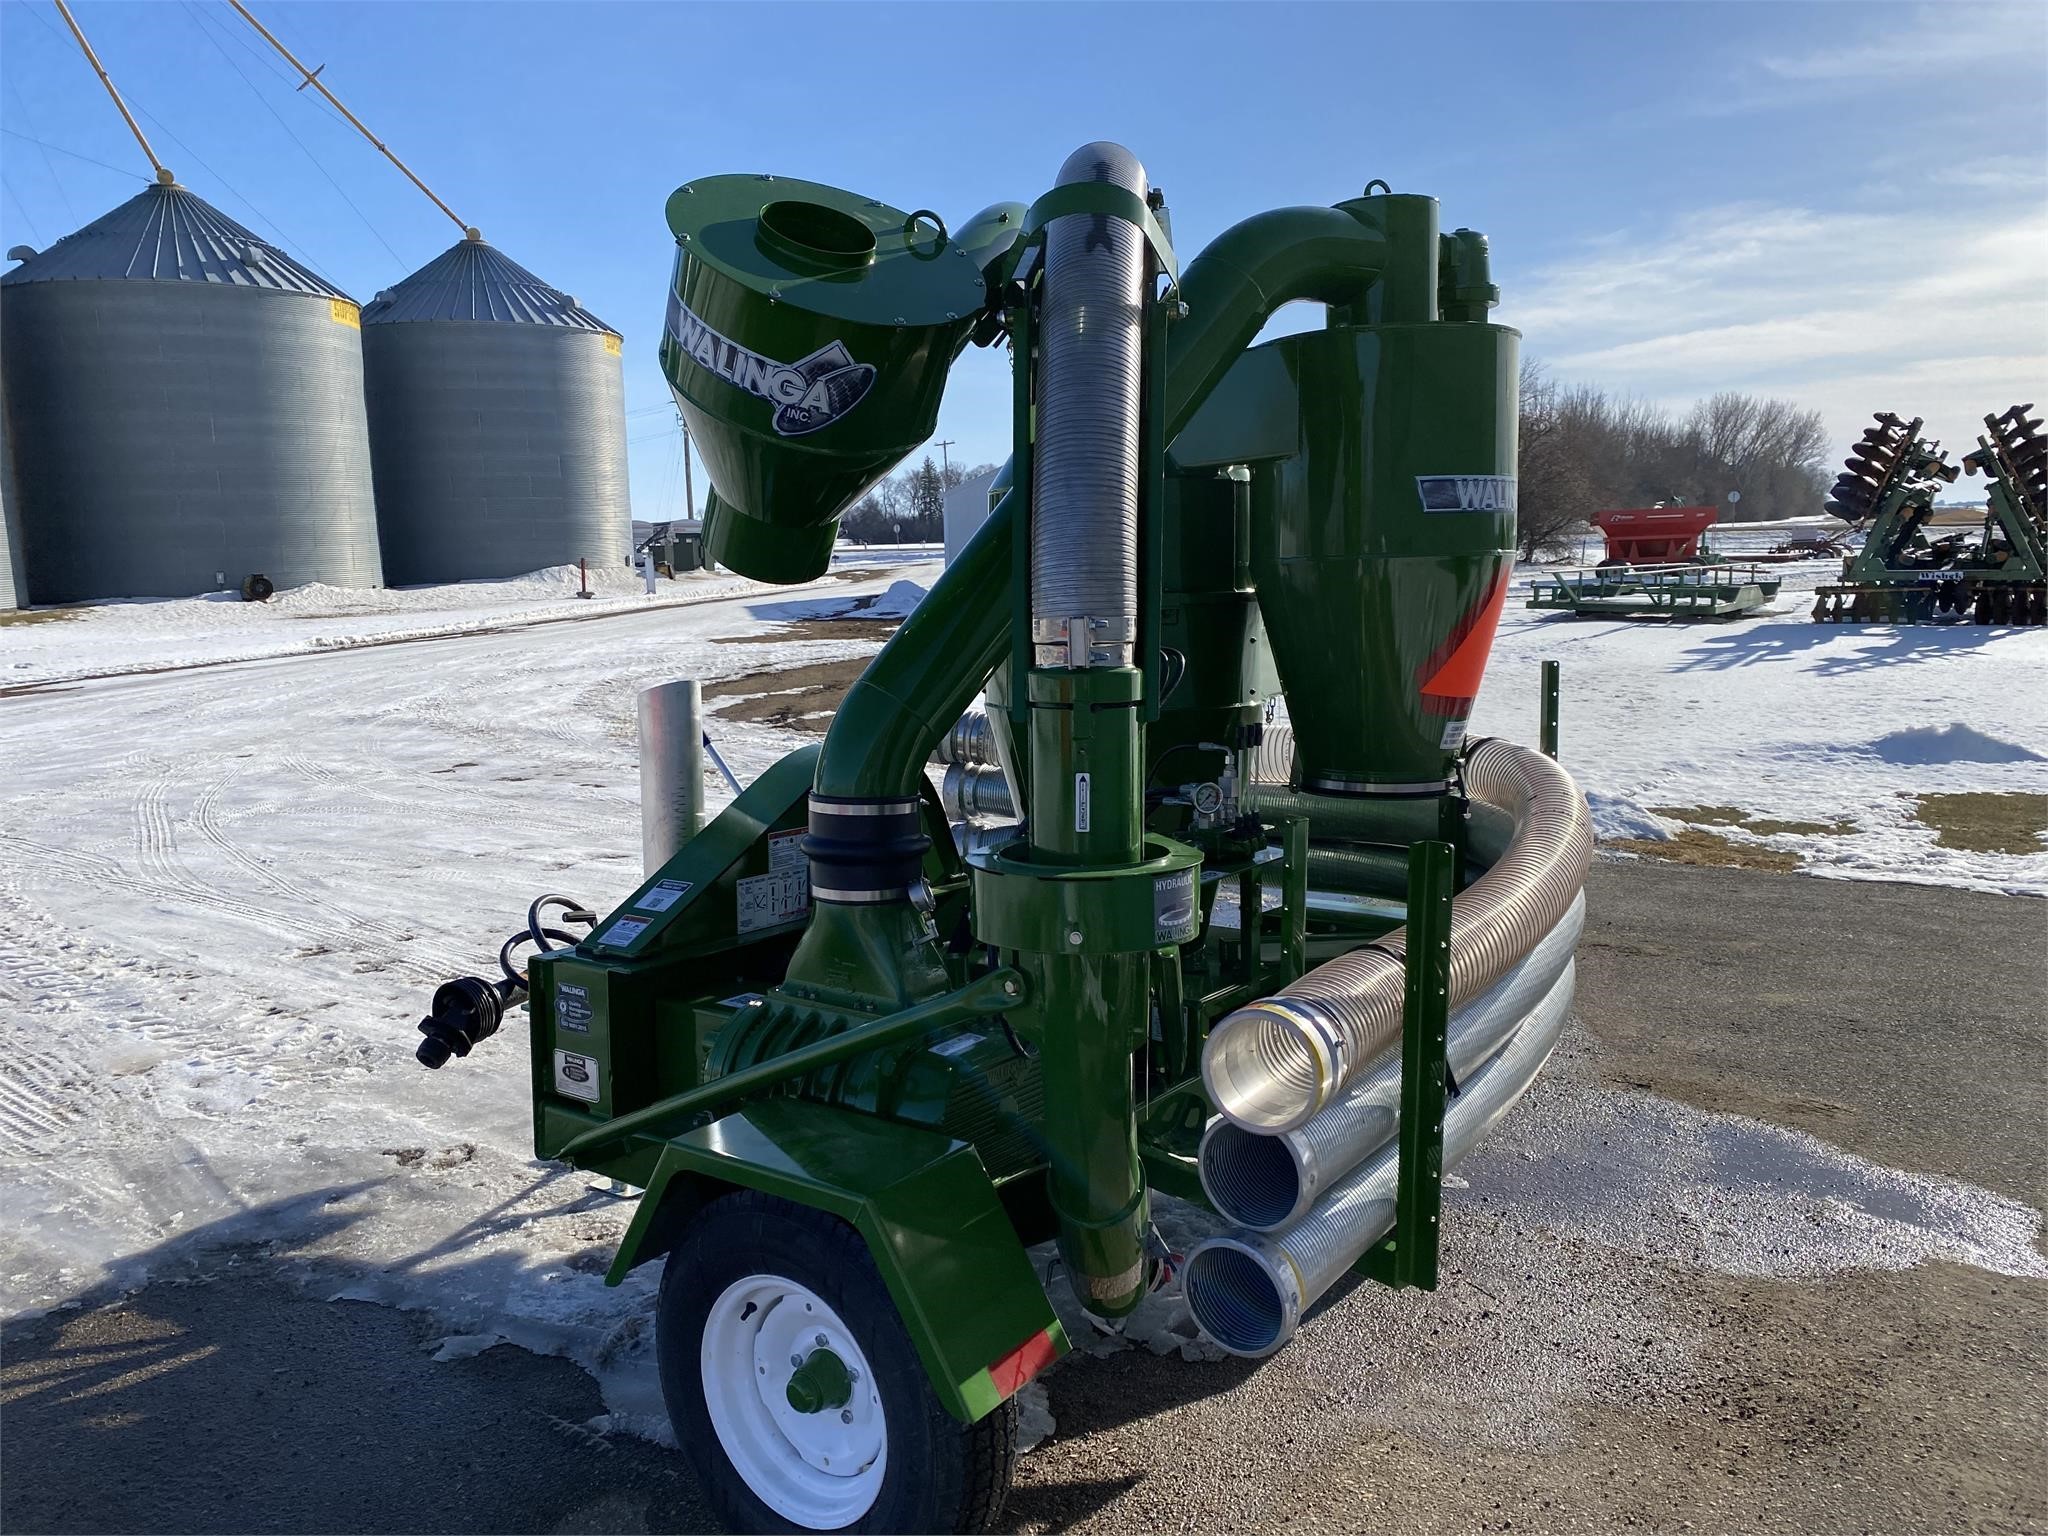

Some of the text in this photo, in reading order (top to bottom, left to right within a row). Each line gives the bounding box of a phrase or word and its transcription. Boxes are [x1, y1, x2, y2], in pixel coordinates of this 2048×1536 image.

[679, 307, 833, 416] WALINGA
[786, 407, 812, 424] INC.
[560, 984, 585, 997] WALINGA
